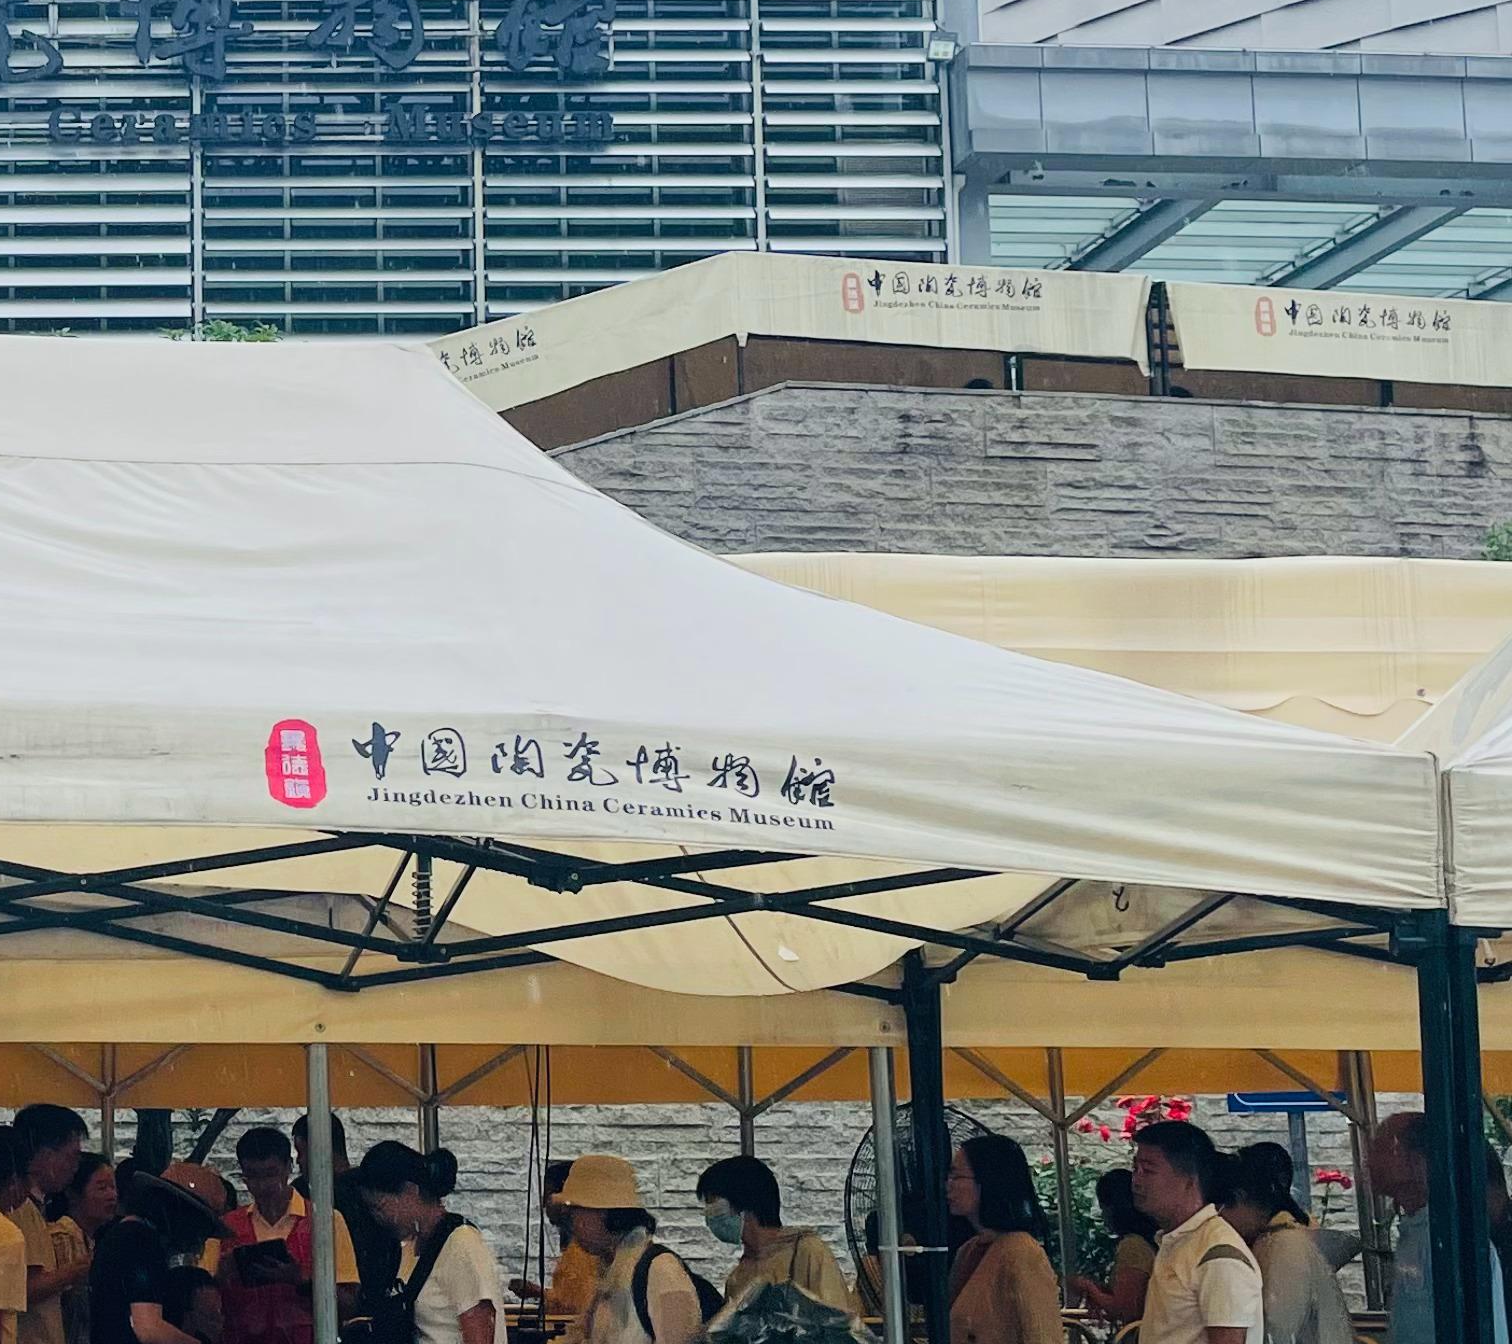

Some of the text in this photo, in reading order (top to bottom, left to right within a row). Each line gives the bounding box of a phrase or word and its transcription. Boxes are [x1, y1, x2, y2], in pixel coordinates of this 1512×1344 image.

[48, 107, 317, 144] Ceramics
[387, 105, 616, 144] Museum
[367, 787, 836, 831] Jingdezhen China Ceramics Museum
